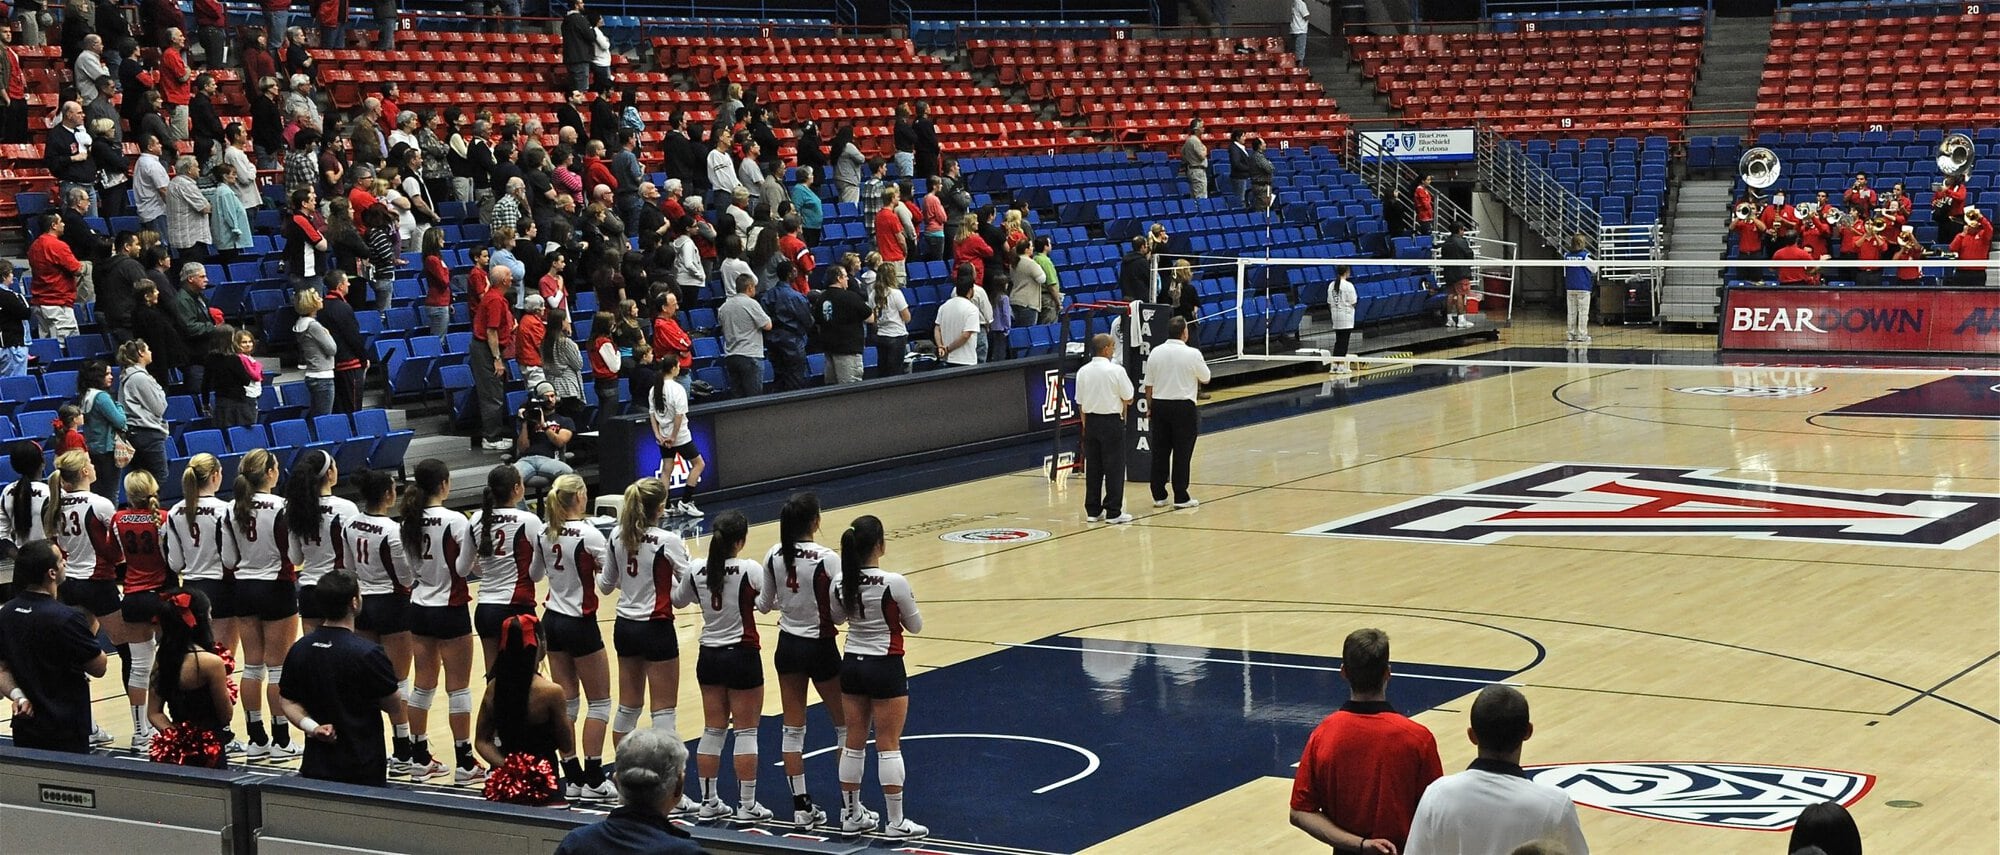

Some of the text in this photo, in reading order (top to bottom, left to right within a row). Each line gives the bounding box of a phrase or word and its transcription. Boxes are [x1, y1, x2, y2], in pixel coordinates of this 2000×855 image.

[1967, 5, 1980, 15] 20
[401, 18, 411, 30] 16
[1526, 23, 1535, 32] 19
[762, 28, 769, 38] 17
[1116, 30, 1125, 40] 18
[1561, 118, 1572, 128] 19
[1870, 124, 1883, 132] 20
[1731, 307, 1924, 333] BEAR DOWN
[60, 511, 82, 537] 23
[120, 513, 156, 524] ARIZON
[190, 522, 200, 548] 9
[246, 516, 258, 542] 8
[348, 520, 383, 536] ARIZONA
[124, 530, 153, 555] 33
[356, 537, 369, 566] 11
[786, 565, 801, 594] 4
